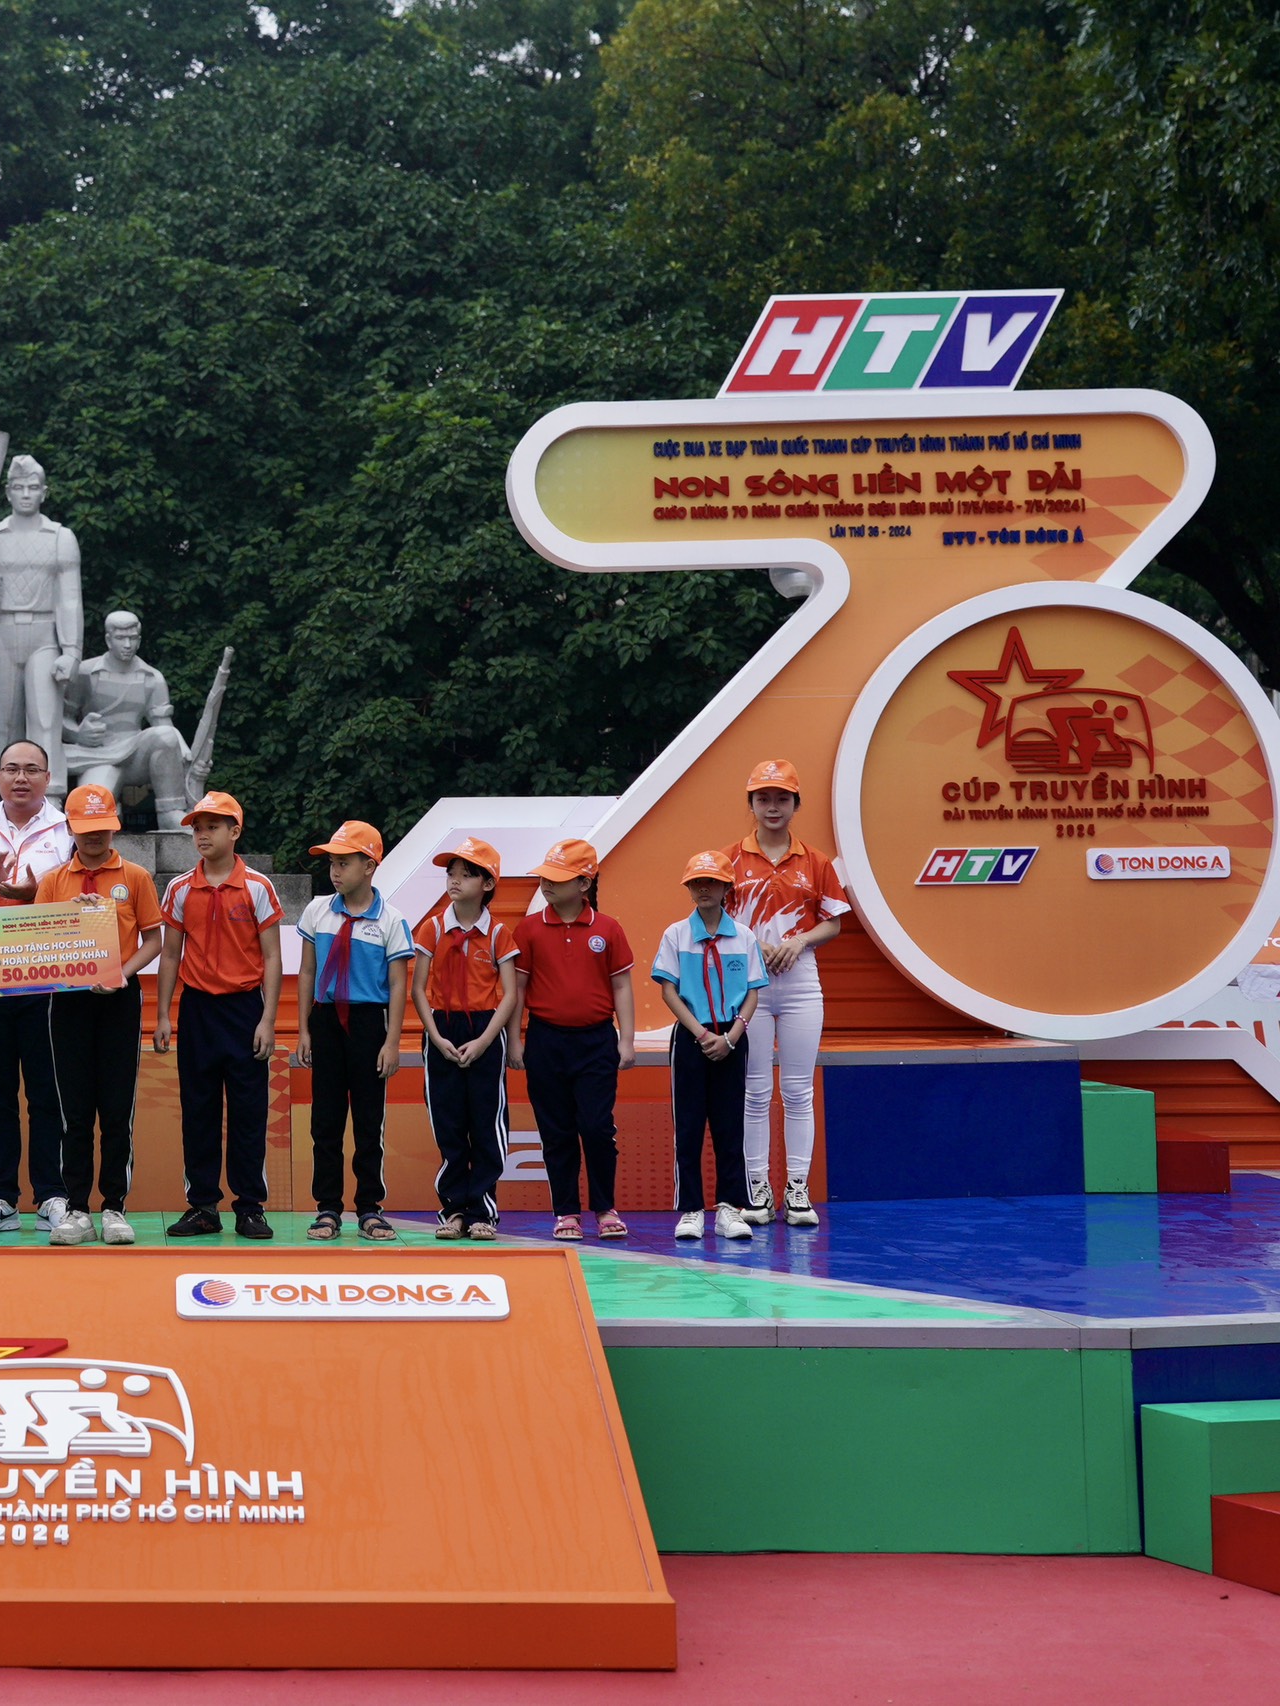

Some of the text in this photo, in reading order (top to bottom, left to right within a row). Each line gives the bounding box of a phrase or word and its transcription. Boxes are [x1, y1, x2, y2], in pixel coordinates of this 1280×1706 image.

[743, 312, 1038, 375] HTV
[653, 439, 680, 459] CUỘC
[683, 441, 705, 457] ĐUA
[708, 441, 723, 456] XE
[725, 440, 747, 459] ĐẠP
[750, 437, 778, 456] TOÀN
[781, 436, 809, 456] QUỐC
[812, 438, 848, 455] TRANH
[851, 436, 873, 455] CÚP
[949, 433, 985, 451] THÀNH
[1031, 432, 1050, 450] CHÍ
[1052, 434, 1081, 450] MINH
[654, 461, 1082, 499] NON SÔNG LIỀN MỘT DẢI
[732, 505, 748, 519] 70
[752, 503, 781, 518] NĂM
[785, 500, 819, 518] CHIẾN
[868, 500, 896, 518] ĐIỆN
[899, 500, 926, 516] BIÊN
[868, 526, 879, 537] 36
[889, 525, 912, 537] 2024
[942, 531, 977, 545] HTV
[987, 527, 1021, 545] TÔN
[941, 772, 1207, 802] CÚP TRUYỀN HÌNH
[943, 802, 1210, 820] ĐÀI TRUYỀN HÌNH THÀNH PHỐ HỒ CHÍ MINH
[1056, 824, 1095, 838] 2024
[926, 854, 1029, 877] HTV
[1116, 855, 1225, 871] TON DONG A
[25, 942, 50, 954] TẶNG
[51, 940, 71, 950] HỌC
[73, 938, 97, 948] SINH
[2, 955, 30, 966] HOÀN
[31, 953, 58, 964] CẢNH
[59, 951, 80, 962] KHÓ
[81, 949, 109, 960] KHĂN
[2, 961, 98, 983] 50.000.000
[244, 1284, 493, 1304] TON DONG A
[165, 1463, 304, 1500] HÌNH
[76, 1497, 132, 1523] PHỐ
[138, 1496, 177, 1523] HỒ
[184, 1500, 233, 1523] CHÍ
[239, 1505, 305, 1524] MINH
